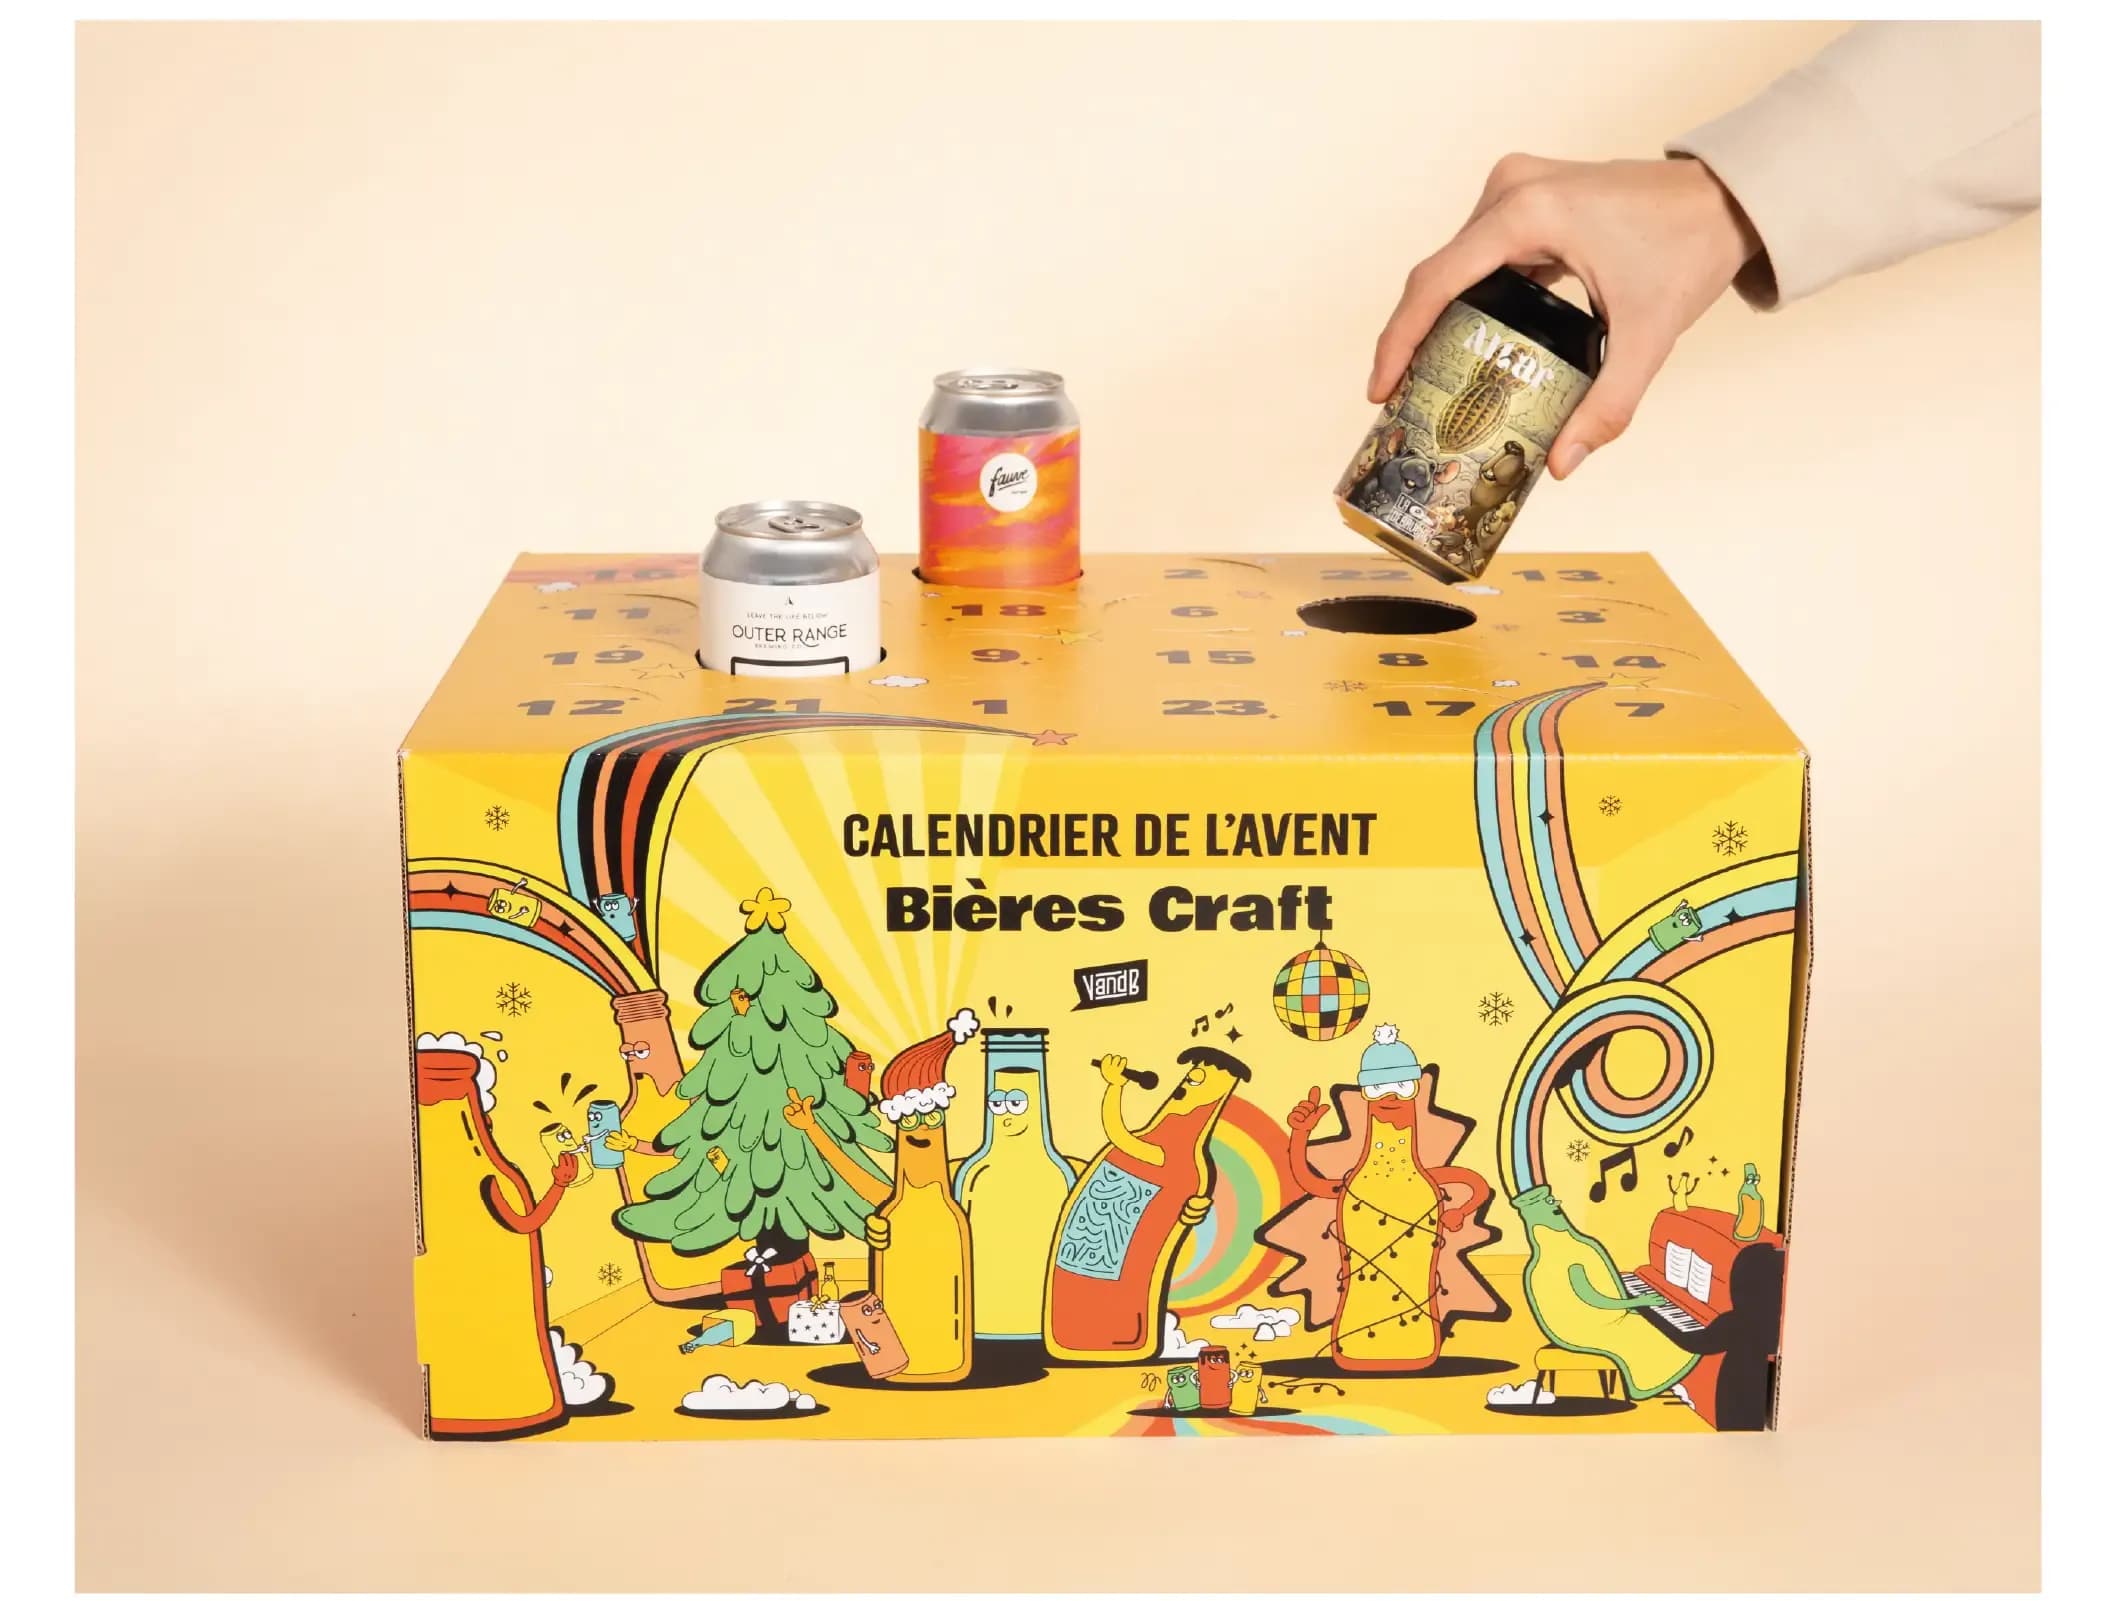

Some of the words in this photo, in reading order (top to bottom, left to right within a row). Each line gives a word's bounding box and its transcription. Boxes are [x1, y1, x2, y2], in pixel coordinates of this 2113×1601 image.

[988, 466, 1030, 498] fauve
[586, 567, 680, 582] 16
[1164, 568, 1209, 580] 2
[1320, 569, 1413, 582] 22
[1511, 569, 1603, 583] 13
[564, 607, 651, 621] 11
[951, 603, 1047, 617] 18
[1170, 605, 1219, 618] 6
[1557, 610, 1606, 624] 3
[731, 624, 786, 642] OUTER
[792, 623, 848, 648] RANGE
[543, 649, 645, 666] 19
[970, 648, 1021, 663] 9
[1155, 650, 1257, 665] 15
[1378, 652, 1429, 667] 8
[1561, 655, 1667, 669] 14
[517, 699, 625, 716] 12
[721, 697, 821, 715] 21
[972, 699, 1009, 715] 1
[1161, 699, 1268, 716] 23
[1372, 700, 1477, 717] 17
[1614, 702, 1665, 718] 7
[843, 813, 1122, 858] CALENDRIER
[1135, 813, 1190, 857] DE
[1206, 812, 1378, 858] L’AVENT
[886, 877, 1125, 932] Bières
[1148, 884, 1333, 931] Craft
[1081, 968, 1140, 1001] VandB
